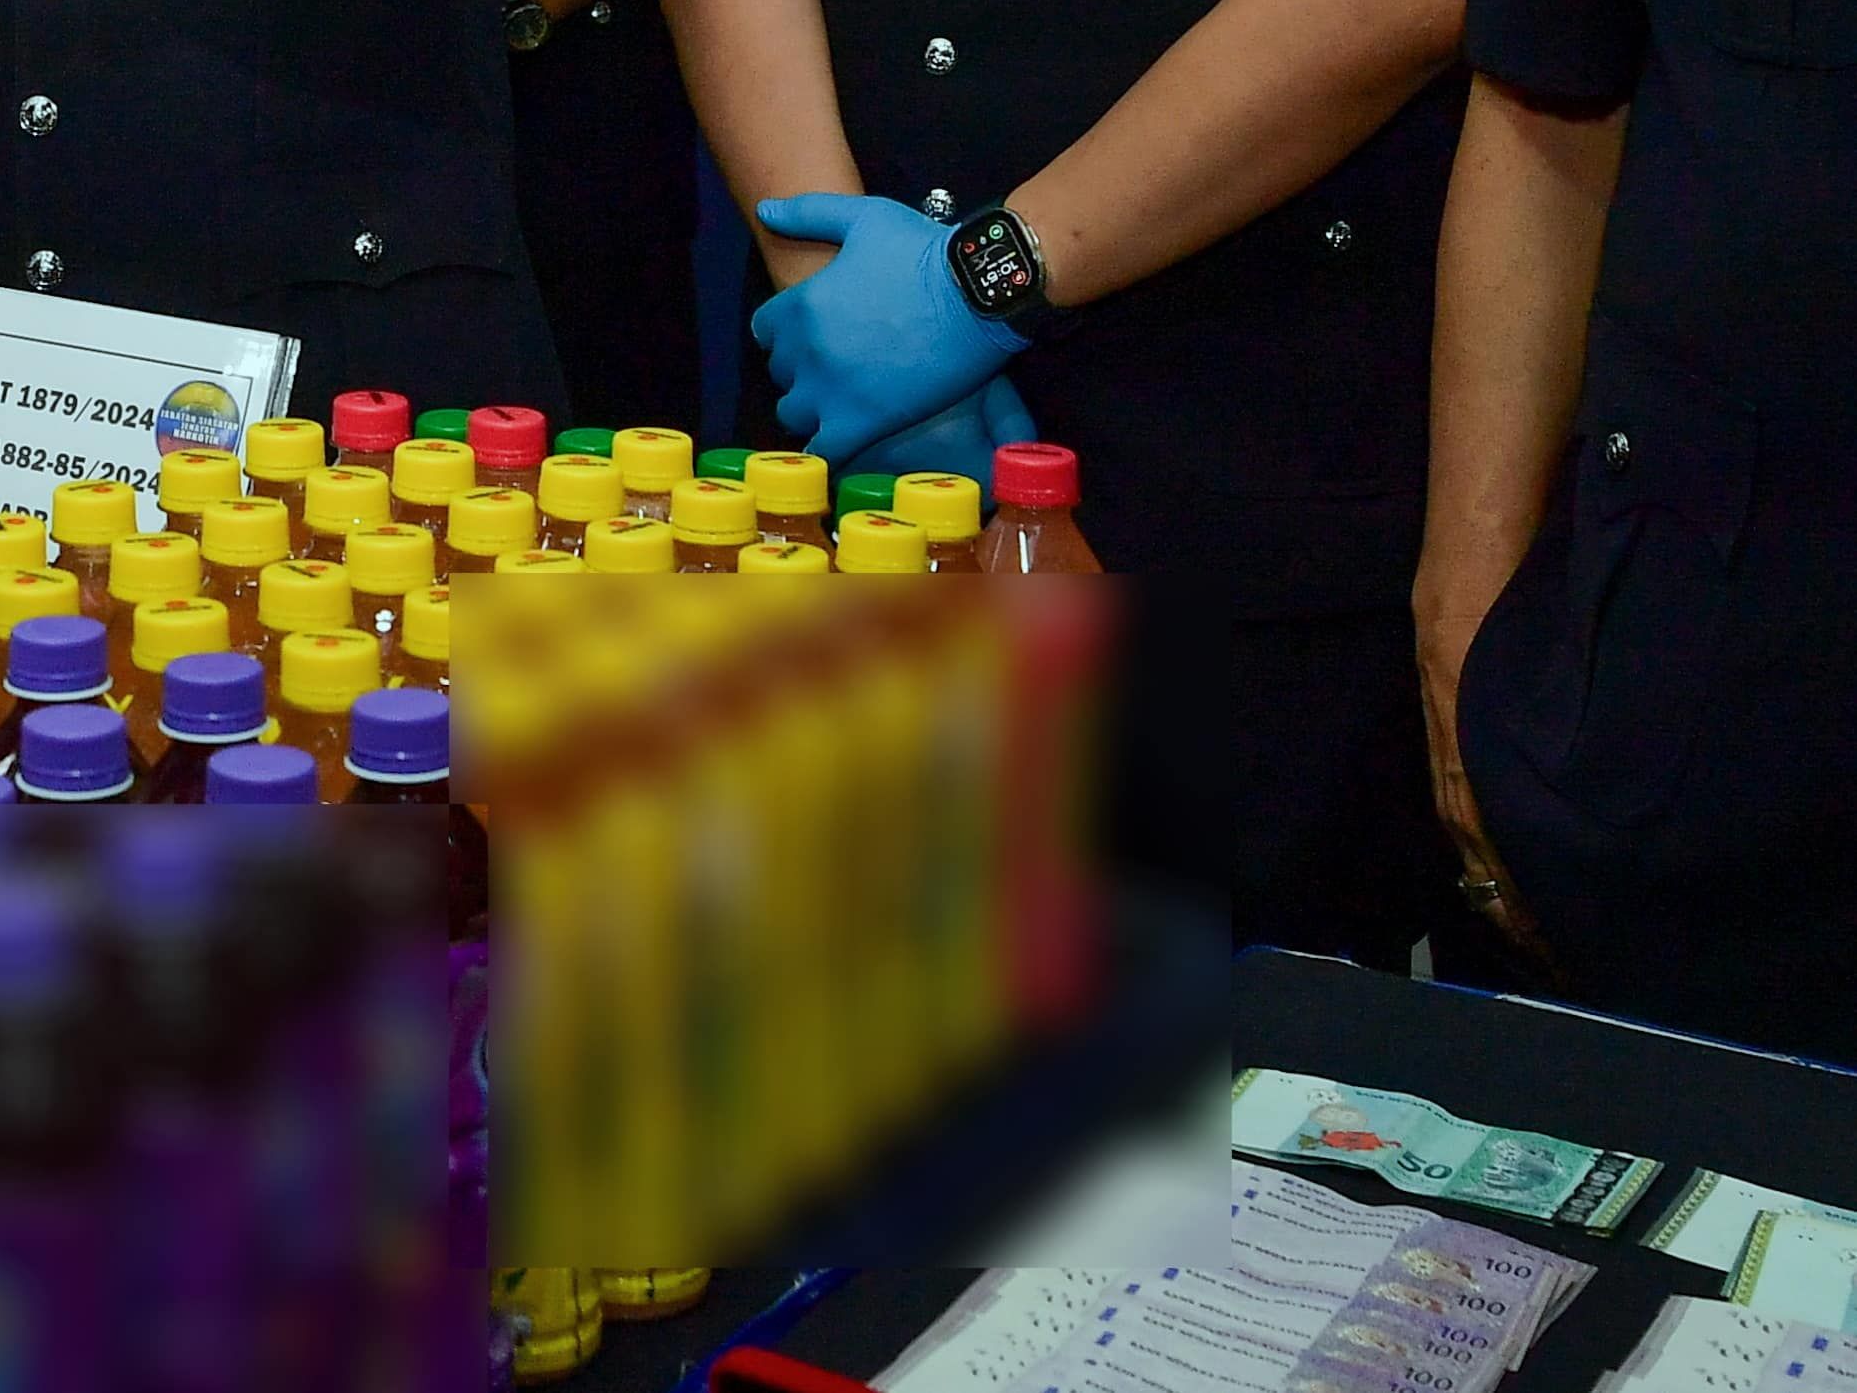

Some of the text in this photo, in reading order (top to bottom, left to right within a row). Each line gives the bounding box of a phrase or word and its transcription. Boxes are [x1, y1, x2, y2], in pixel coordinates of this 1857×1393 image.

[979, 260, 1020, 288] 10:51
[17, 384, 156, 432] 1879/2024
[1397, 1150, 1453, 1180] 50
[1485, 1258, 1532, 1280] 100
[1457, 1294, 1506, 1316] 100
[1441, 1325, 1488, 1349] 100
[1424, 1340, 1472, 1364] 100
[1405, 1366, 1454, 1391] 100
